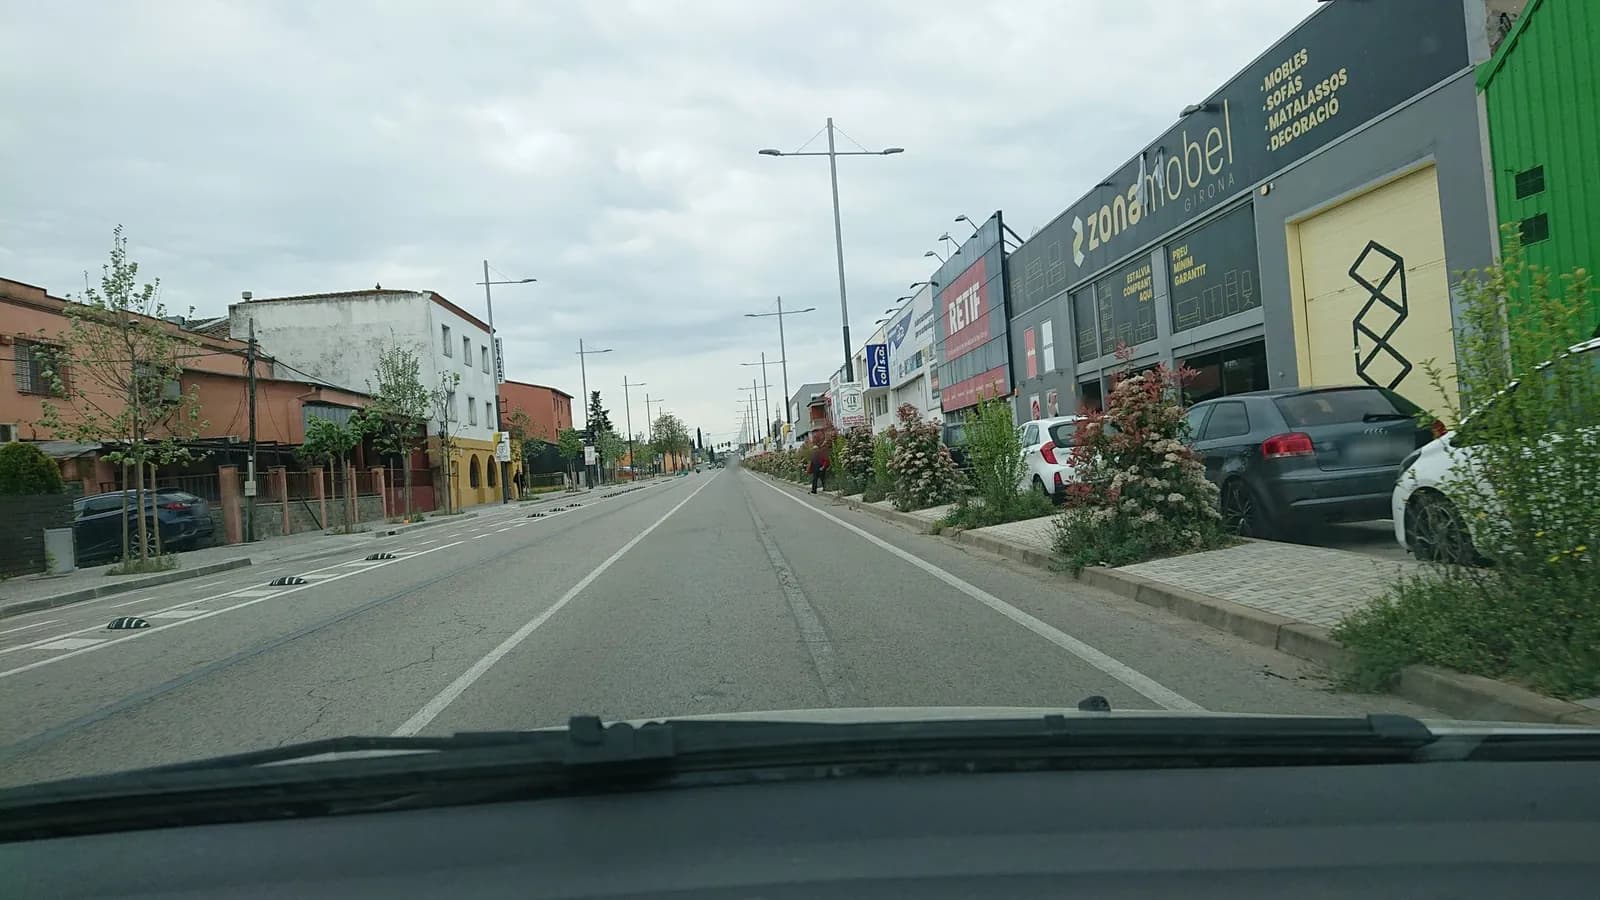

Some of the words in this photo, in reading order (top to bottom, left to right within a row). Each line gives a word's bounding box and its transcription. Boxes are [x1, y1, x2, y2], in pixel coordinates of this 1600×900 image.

[1264, 48, 1309, 92] MOBLES
[1268, 68, 1348, 132] MATALASSOS
[1270, 94, 1340, 152] DECORACIÓ
[1184, 173, 1236, 213] GIRONA
[1172, 243, 1188, 260] PREU
[1123, 277, 1152, 297] COMPRANT
[1127, 264, 1151, 284] ESTALVIA
[1174, 263, 1207, 286] GARANTIT
[948, 281, 981, 335] RETIF
[877, 365, 888, 385] coll
